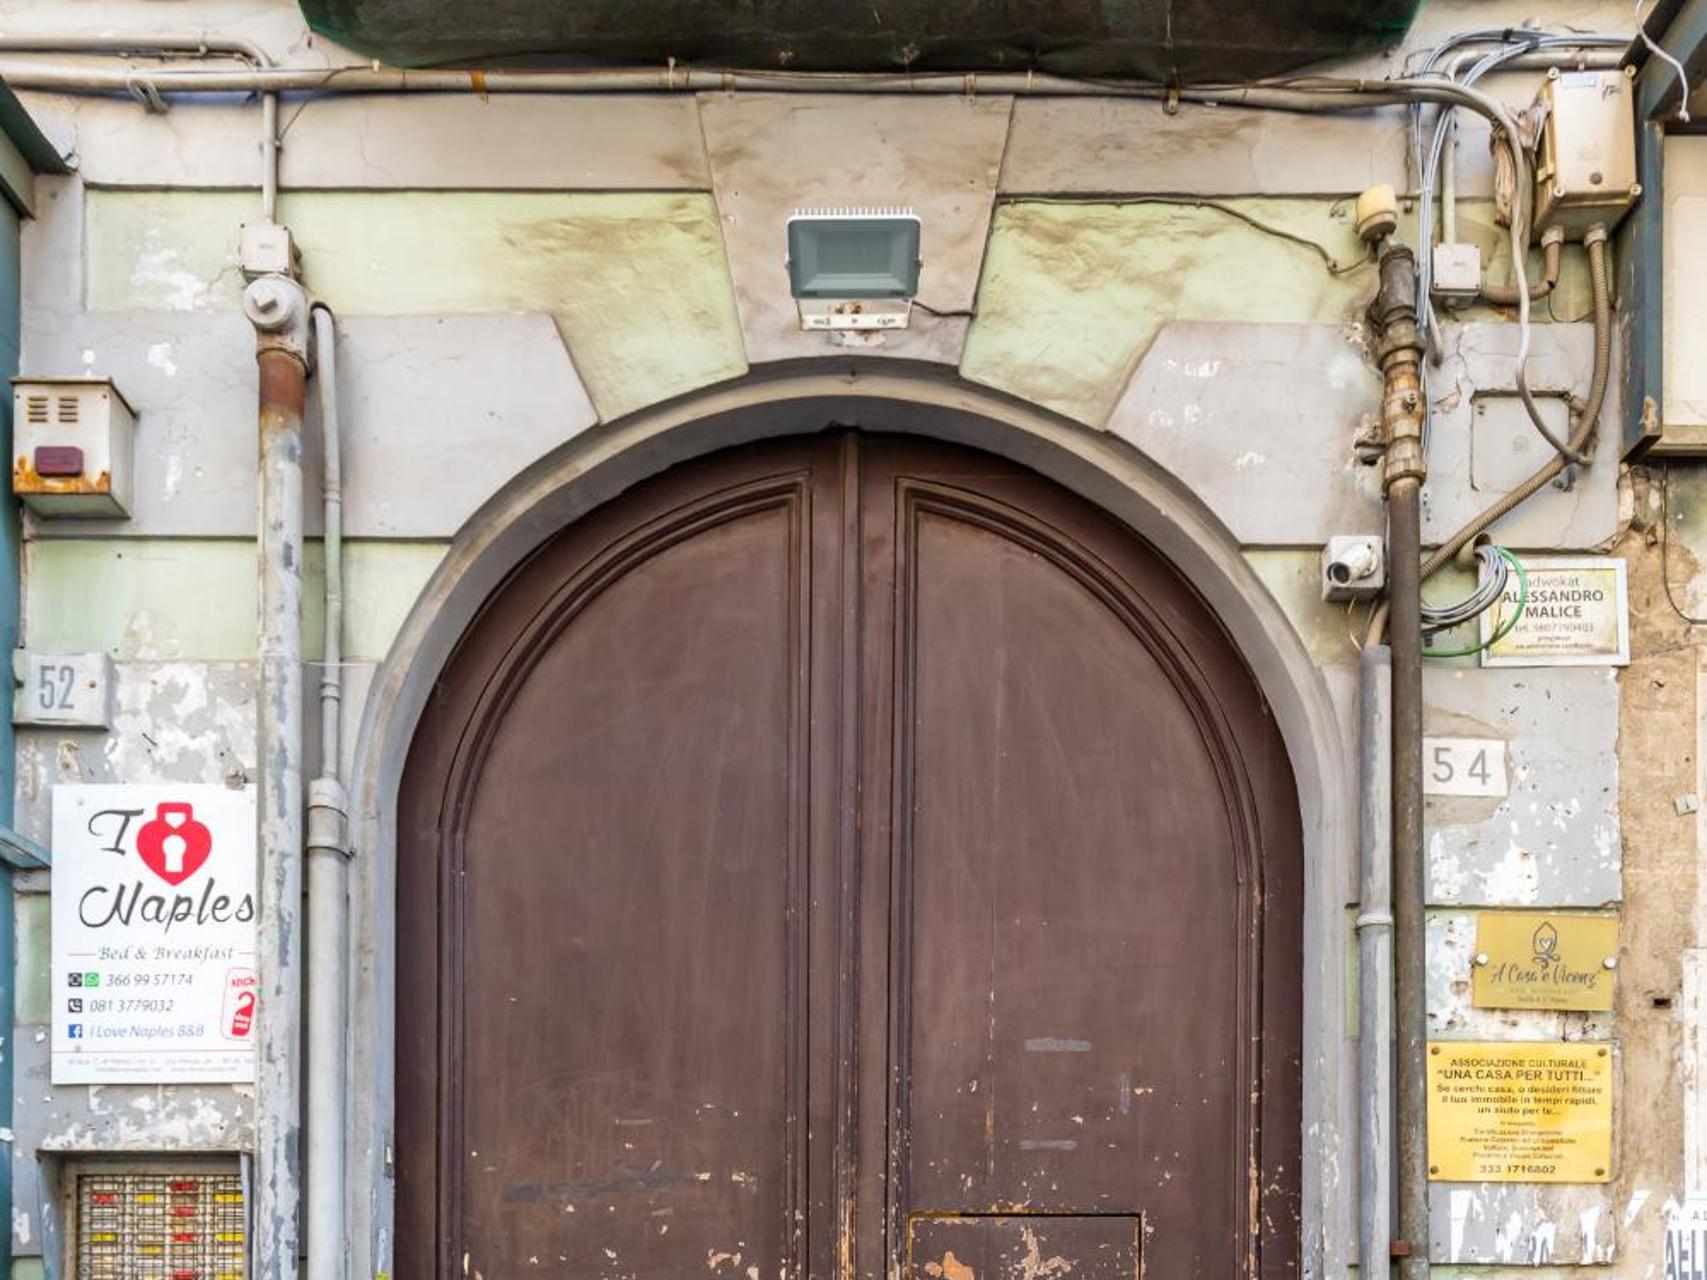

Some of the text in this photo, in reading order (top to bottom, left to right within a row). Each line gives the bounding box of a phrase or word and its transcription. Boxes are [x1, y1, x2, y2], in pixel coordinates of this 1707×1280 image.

[1502, 590, 1604, 603] ALESSANDRO
[1525, 606, 1582, 618] MALICE
[40, 665, 74, 709] 52
[1432, 747, 1491, 786] 54
[79, 877, 254, 936] Naples
[99, 945, 234, 961] Bed & Breakfast
[106, 973, 131, 987] 366
[134, 973, 150, 986] 99
[90, 999, 174, 1012] 081 3779032
[97, 1026, 127, 1038] Love
[131, 1025, 174, 1040] Naples
[178, 1025, 205, 1037] B&B
[1450, 1059, 1587, 1069] ASSOCIAZIONE CULTURALE
[1476, 1069, 1512, 1081] CASA
[1516, 1070, 1542, 1081] PER
[1437, 1084, 1450, 1093] Se
[1453, 1085, 1485, 1093] cerchi
[1471, 1096, 1518, 1104] immobile
[1534, 1096, 1563, 1106] tempi
[1522, 1107, 1539, 1116] per
[1480, 1165, 1501, 1173] 333
